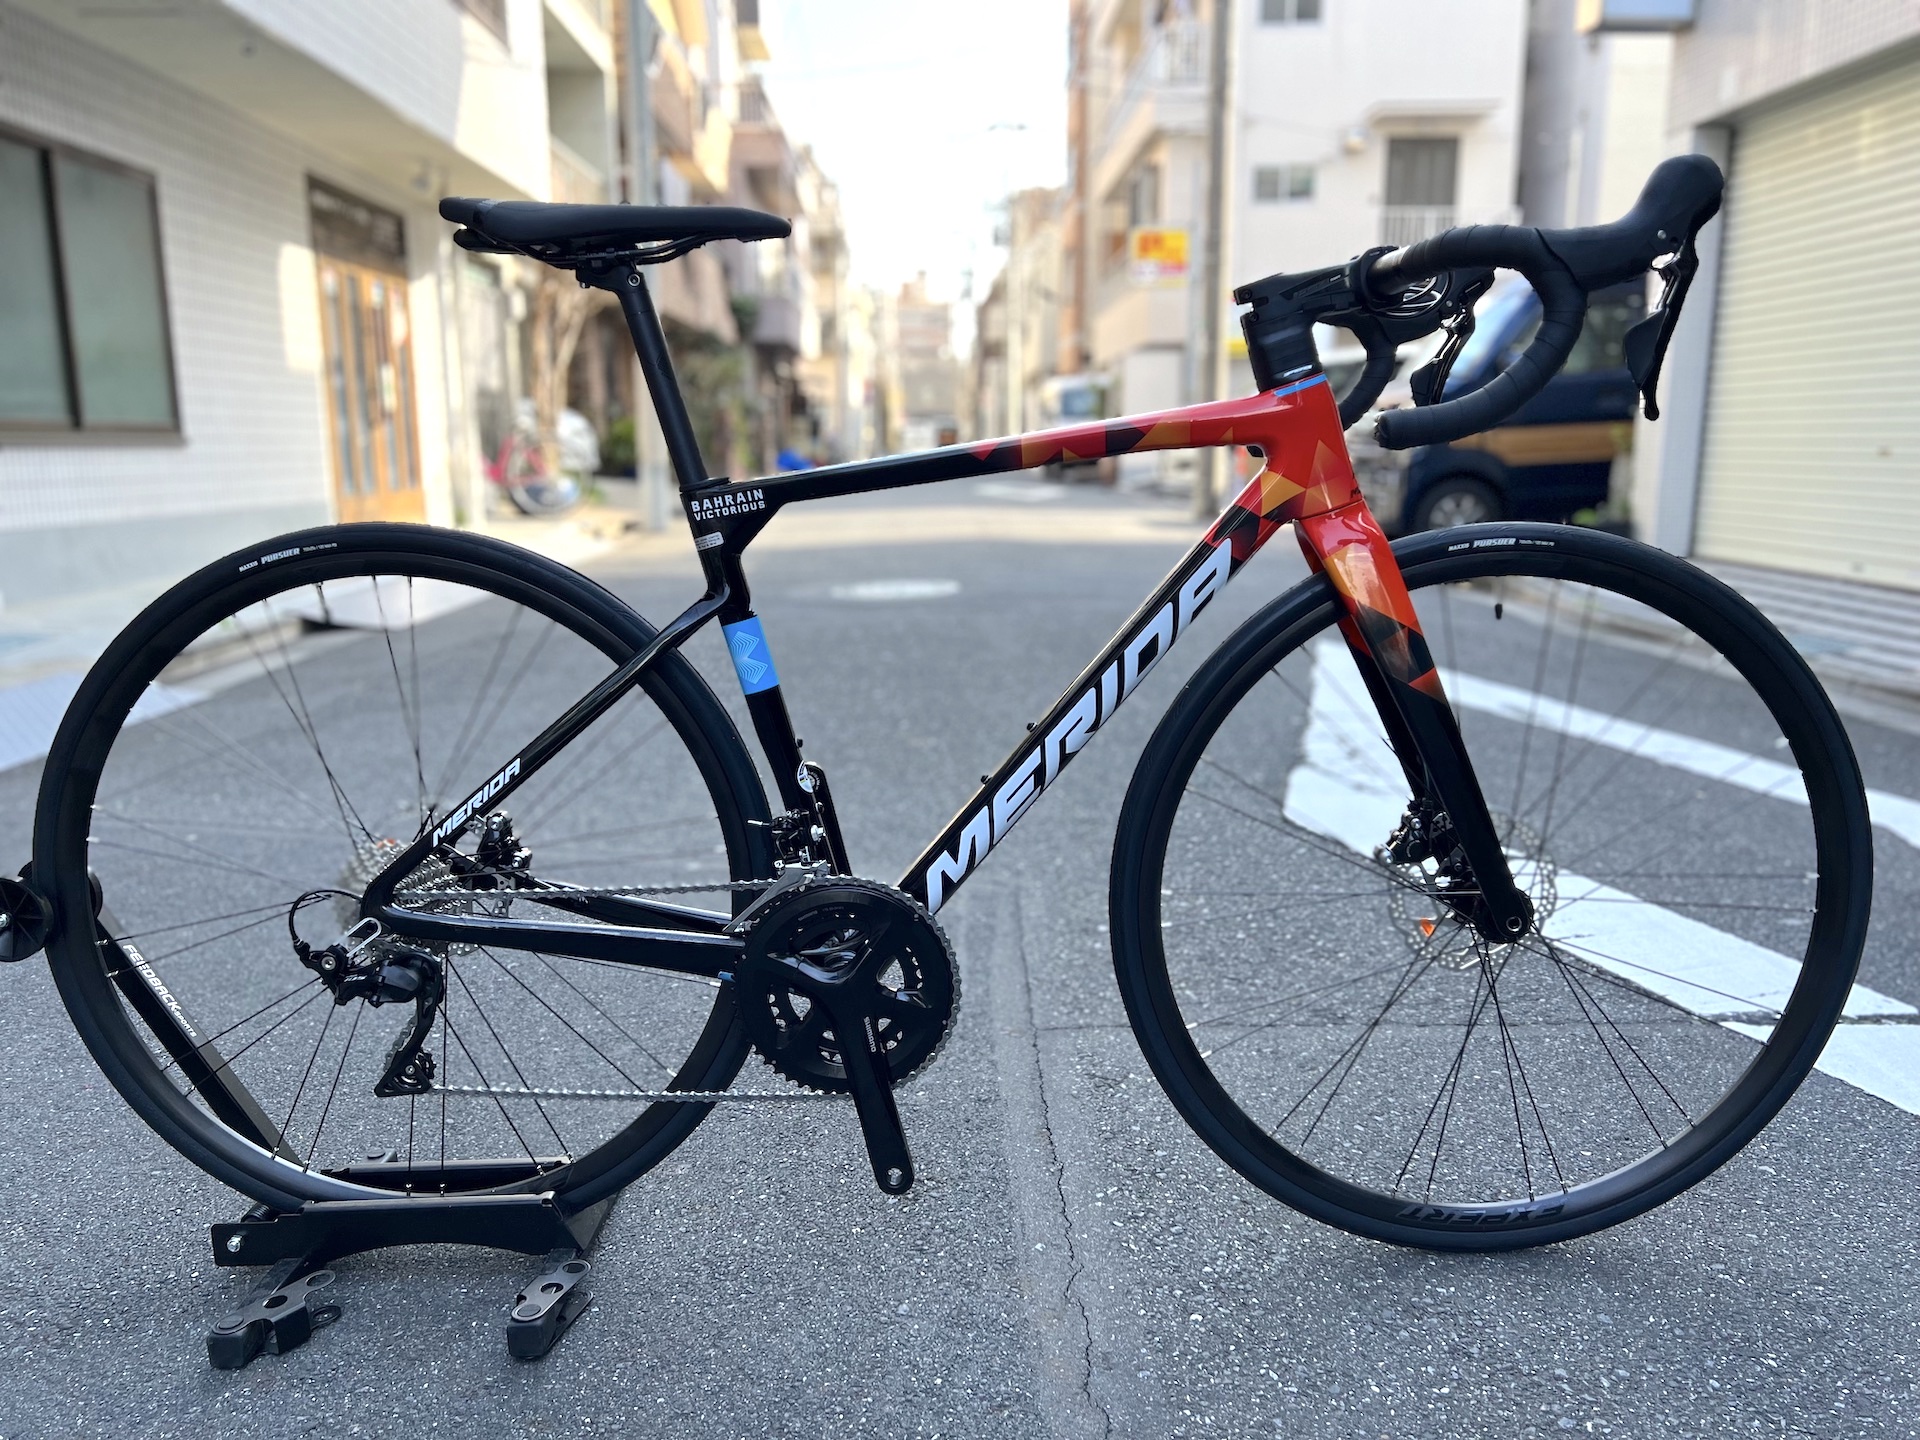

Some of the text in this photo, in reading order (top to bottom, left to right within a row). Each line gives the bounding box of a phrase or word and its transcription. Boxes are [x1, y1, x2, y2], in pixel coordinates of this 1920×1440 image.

[691, 489, 764, 512] BAHRAIN
[693, 500, 766, 521] VICTORIOUS
[1472, 538, 1516, 548] PURSUER
[261, 548, 300, 564] PURSUER
[926, 537, 1232, 918] MERIDA
[432, 757, 521, 848] MERIDA
[123, 944, 182, 1012] FEEDBACK
